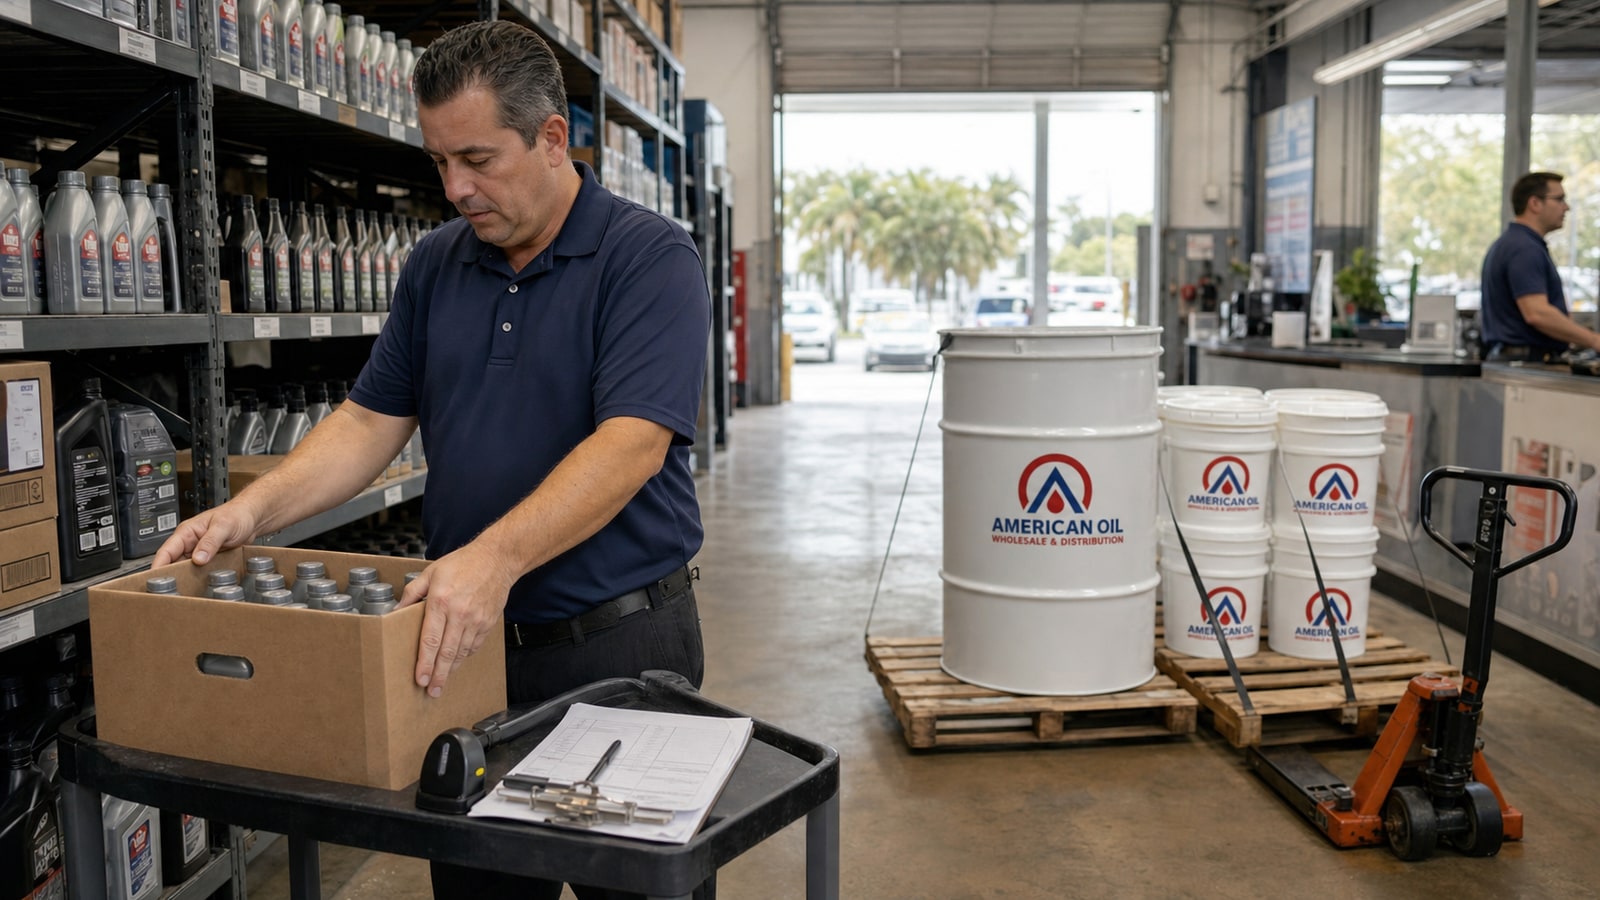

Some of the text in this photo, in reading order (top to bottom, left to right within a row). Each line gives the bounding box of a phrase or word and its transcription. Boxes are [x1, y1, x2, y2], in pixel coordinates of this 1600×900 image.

[1188, 494, 1259, 506] AMERICAN OIL
[1295, 500, 1353, 511] AMERICAN
[992, 518, 1123, 535] AMERICAN OIL
[991, 535, 1124, 546] WHOLESALE & DISTRIBUTION
[1188, 625, 1242, 636] AMERCAN
